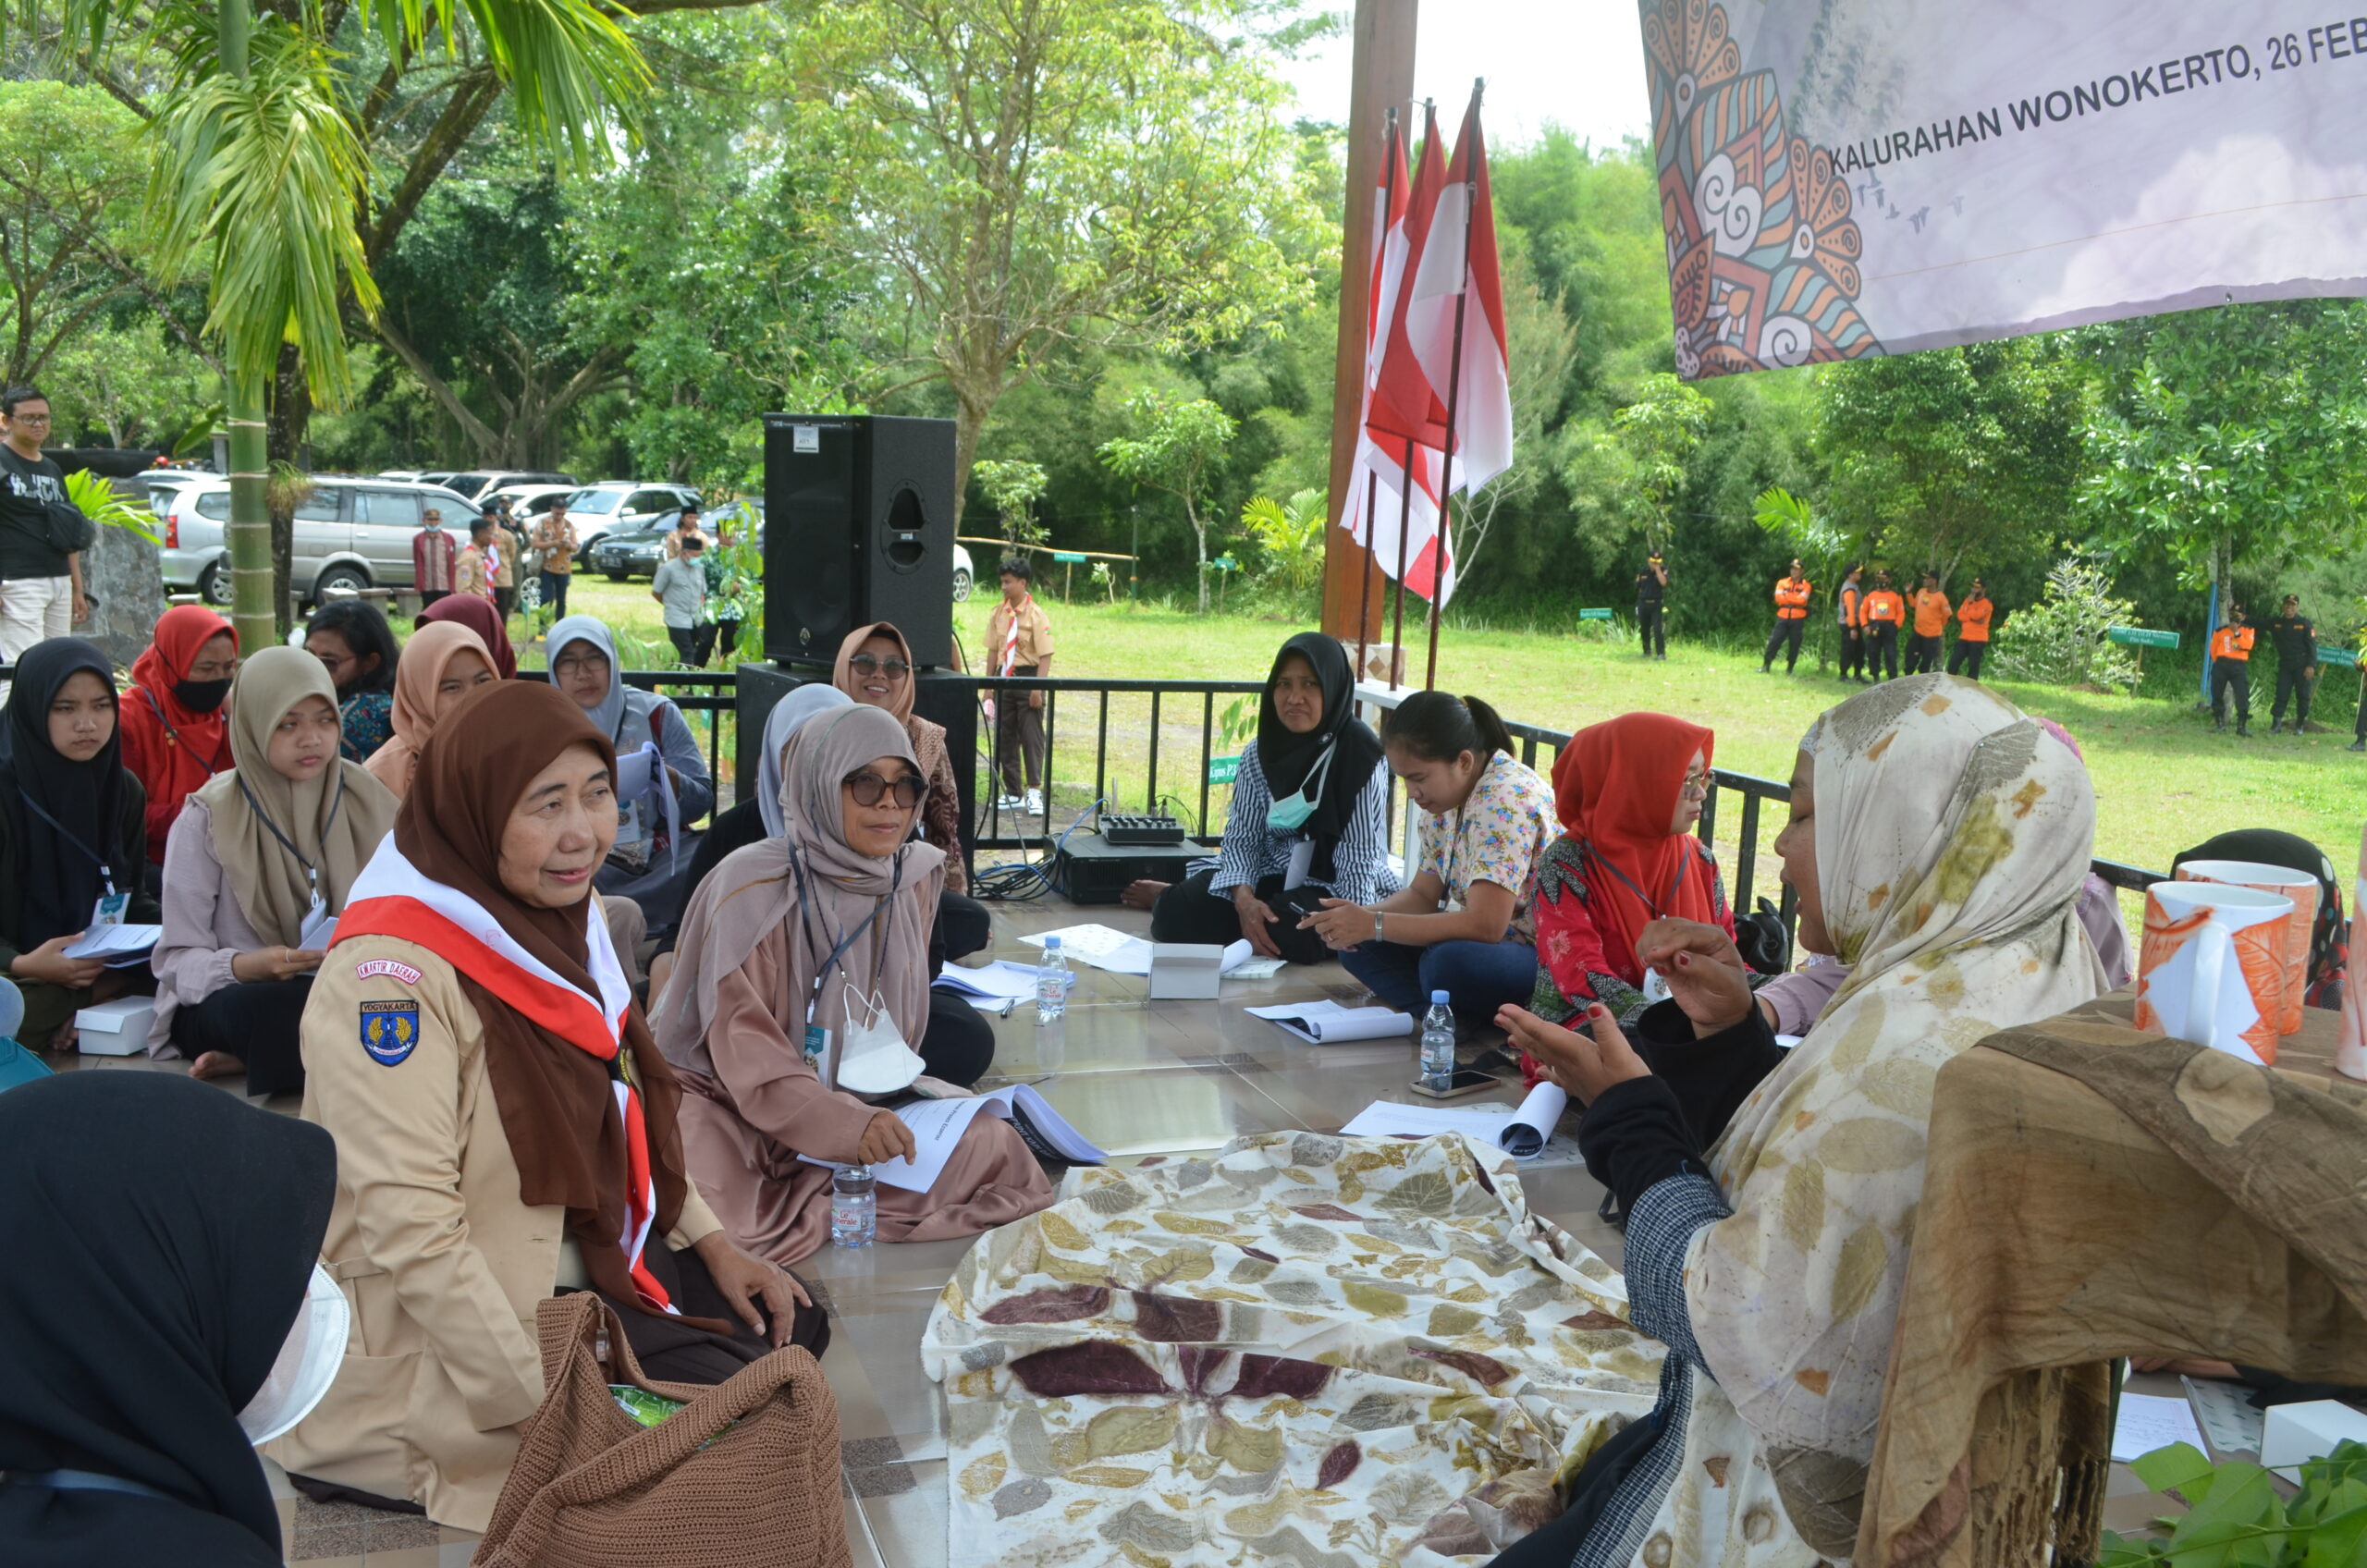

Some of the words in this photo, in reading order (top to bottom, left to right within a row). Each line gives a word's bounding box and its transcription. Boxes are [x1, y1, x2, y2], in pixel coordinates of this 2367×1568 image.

[1829, 107, 2003, 177] KALURAHAN
[2007, 44, 2262, 131] WONOKERTO,
[2266, 32, 2302, 70] 26
[359, 961, 387, 977] KWARTIR
[389, 962, 418, 983] DAERAH
[363, 1003, 416, 1011] YOGYAKARTA
